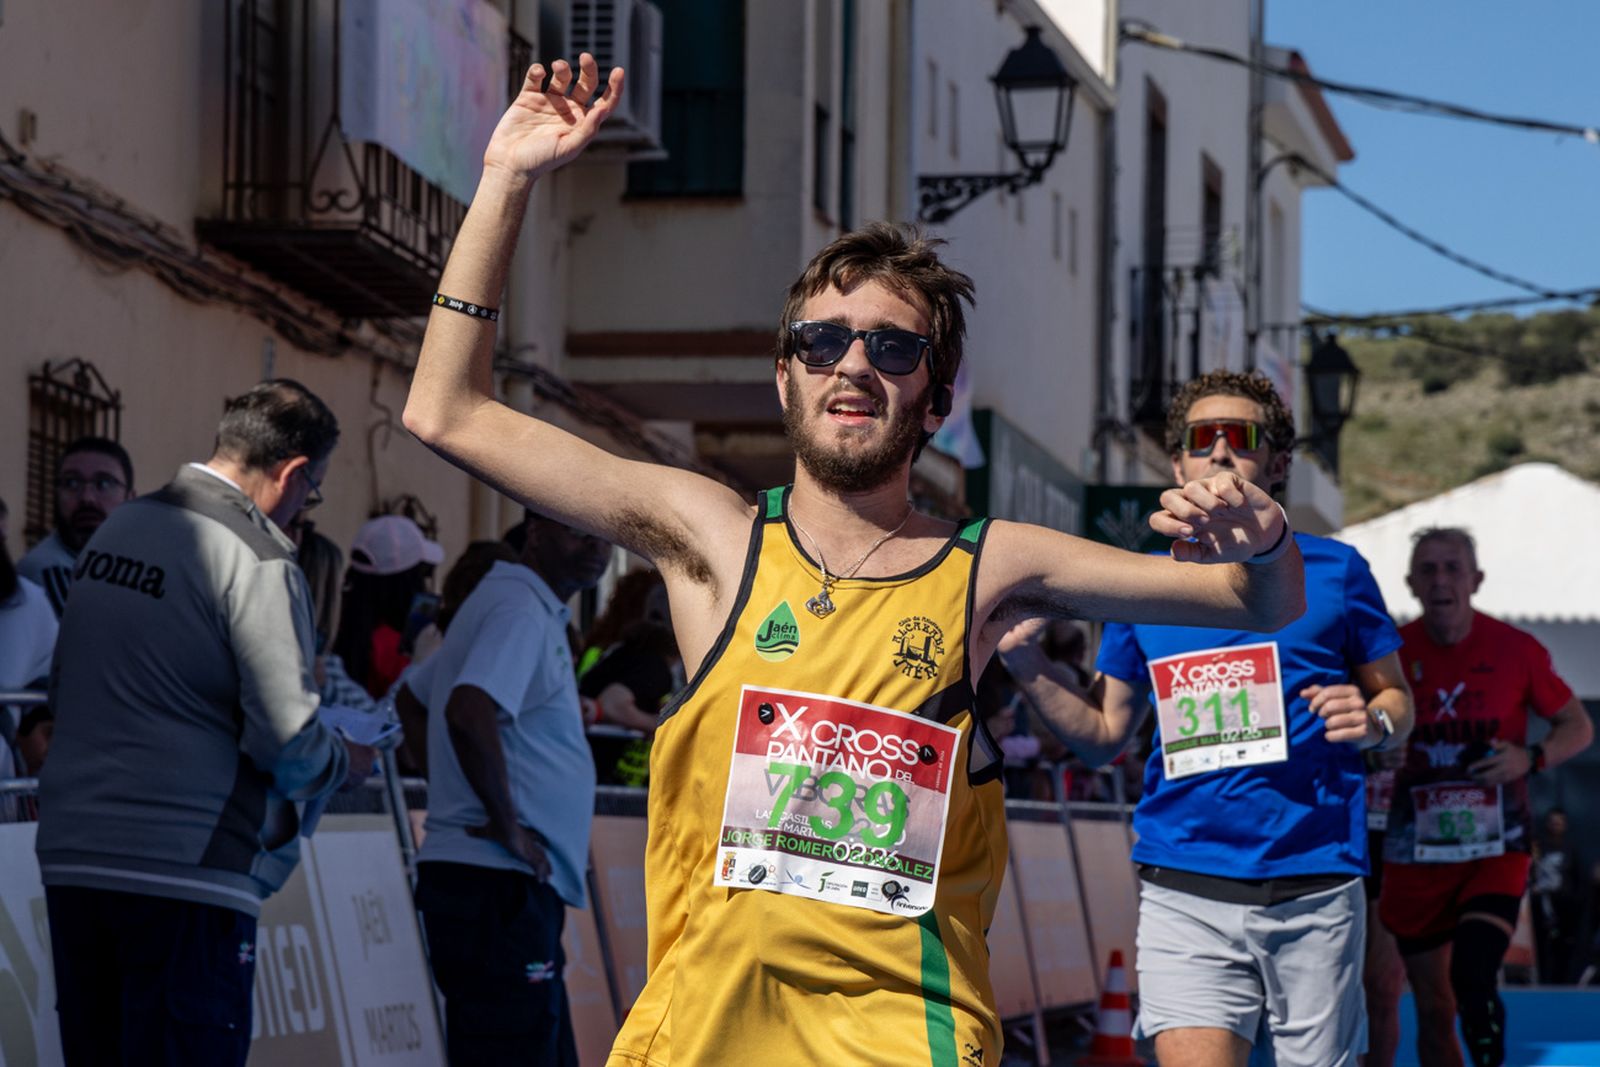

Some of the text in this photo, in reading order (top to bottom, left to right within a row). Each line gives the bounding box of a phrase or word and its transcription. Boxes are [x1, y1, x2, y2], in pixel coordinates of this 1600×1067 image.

[75, 550, 165, 599] Joma
[757, 620, 797, 642] Jaén
[1167, 661, 1187, 688] X
[1187, 658, 1256, 684] CROSS
[1176, 688, 1250, 738] 311
[771, 702, 920, 767] X CROSS
[765, 740, 892, 782] PANTANO
[766, 761, 909, 849] 739
[722, 829, 774, 847] JORGE
[775, 833, 846, 862] ROMERO
[1440, 811, 1476, 842] 63
